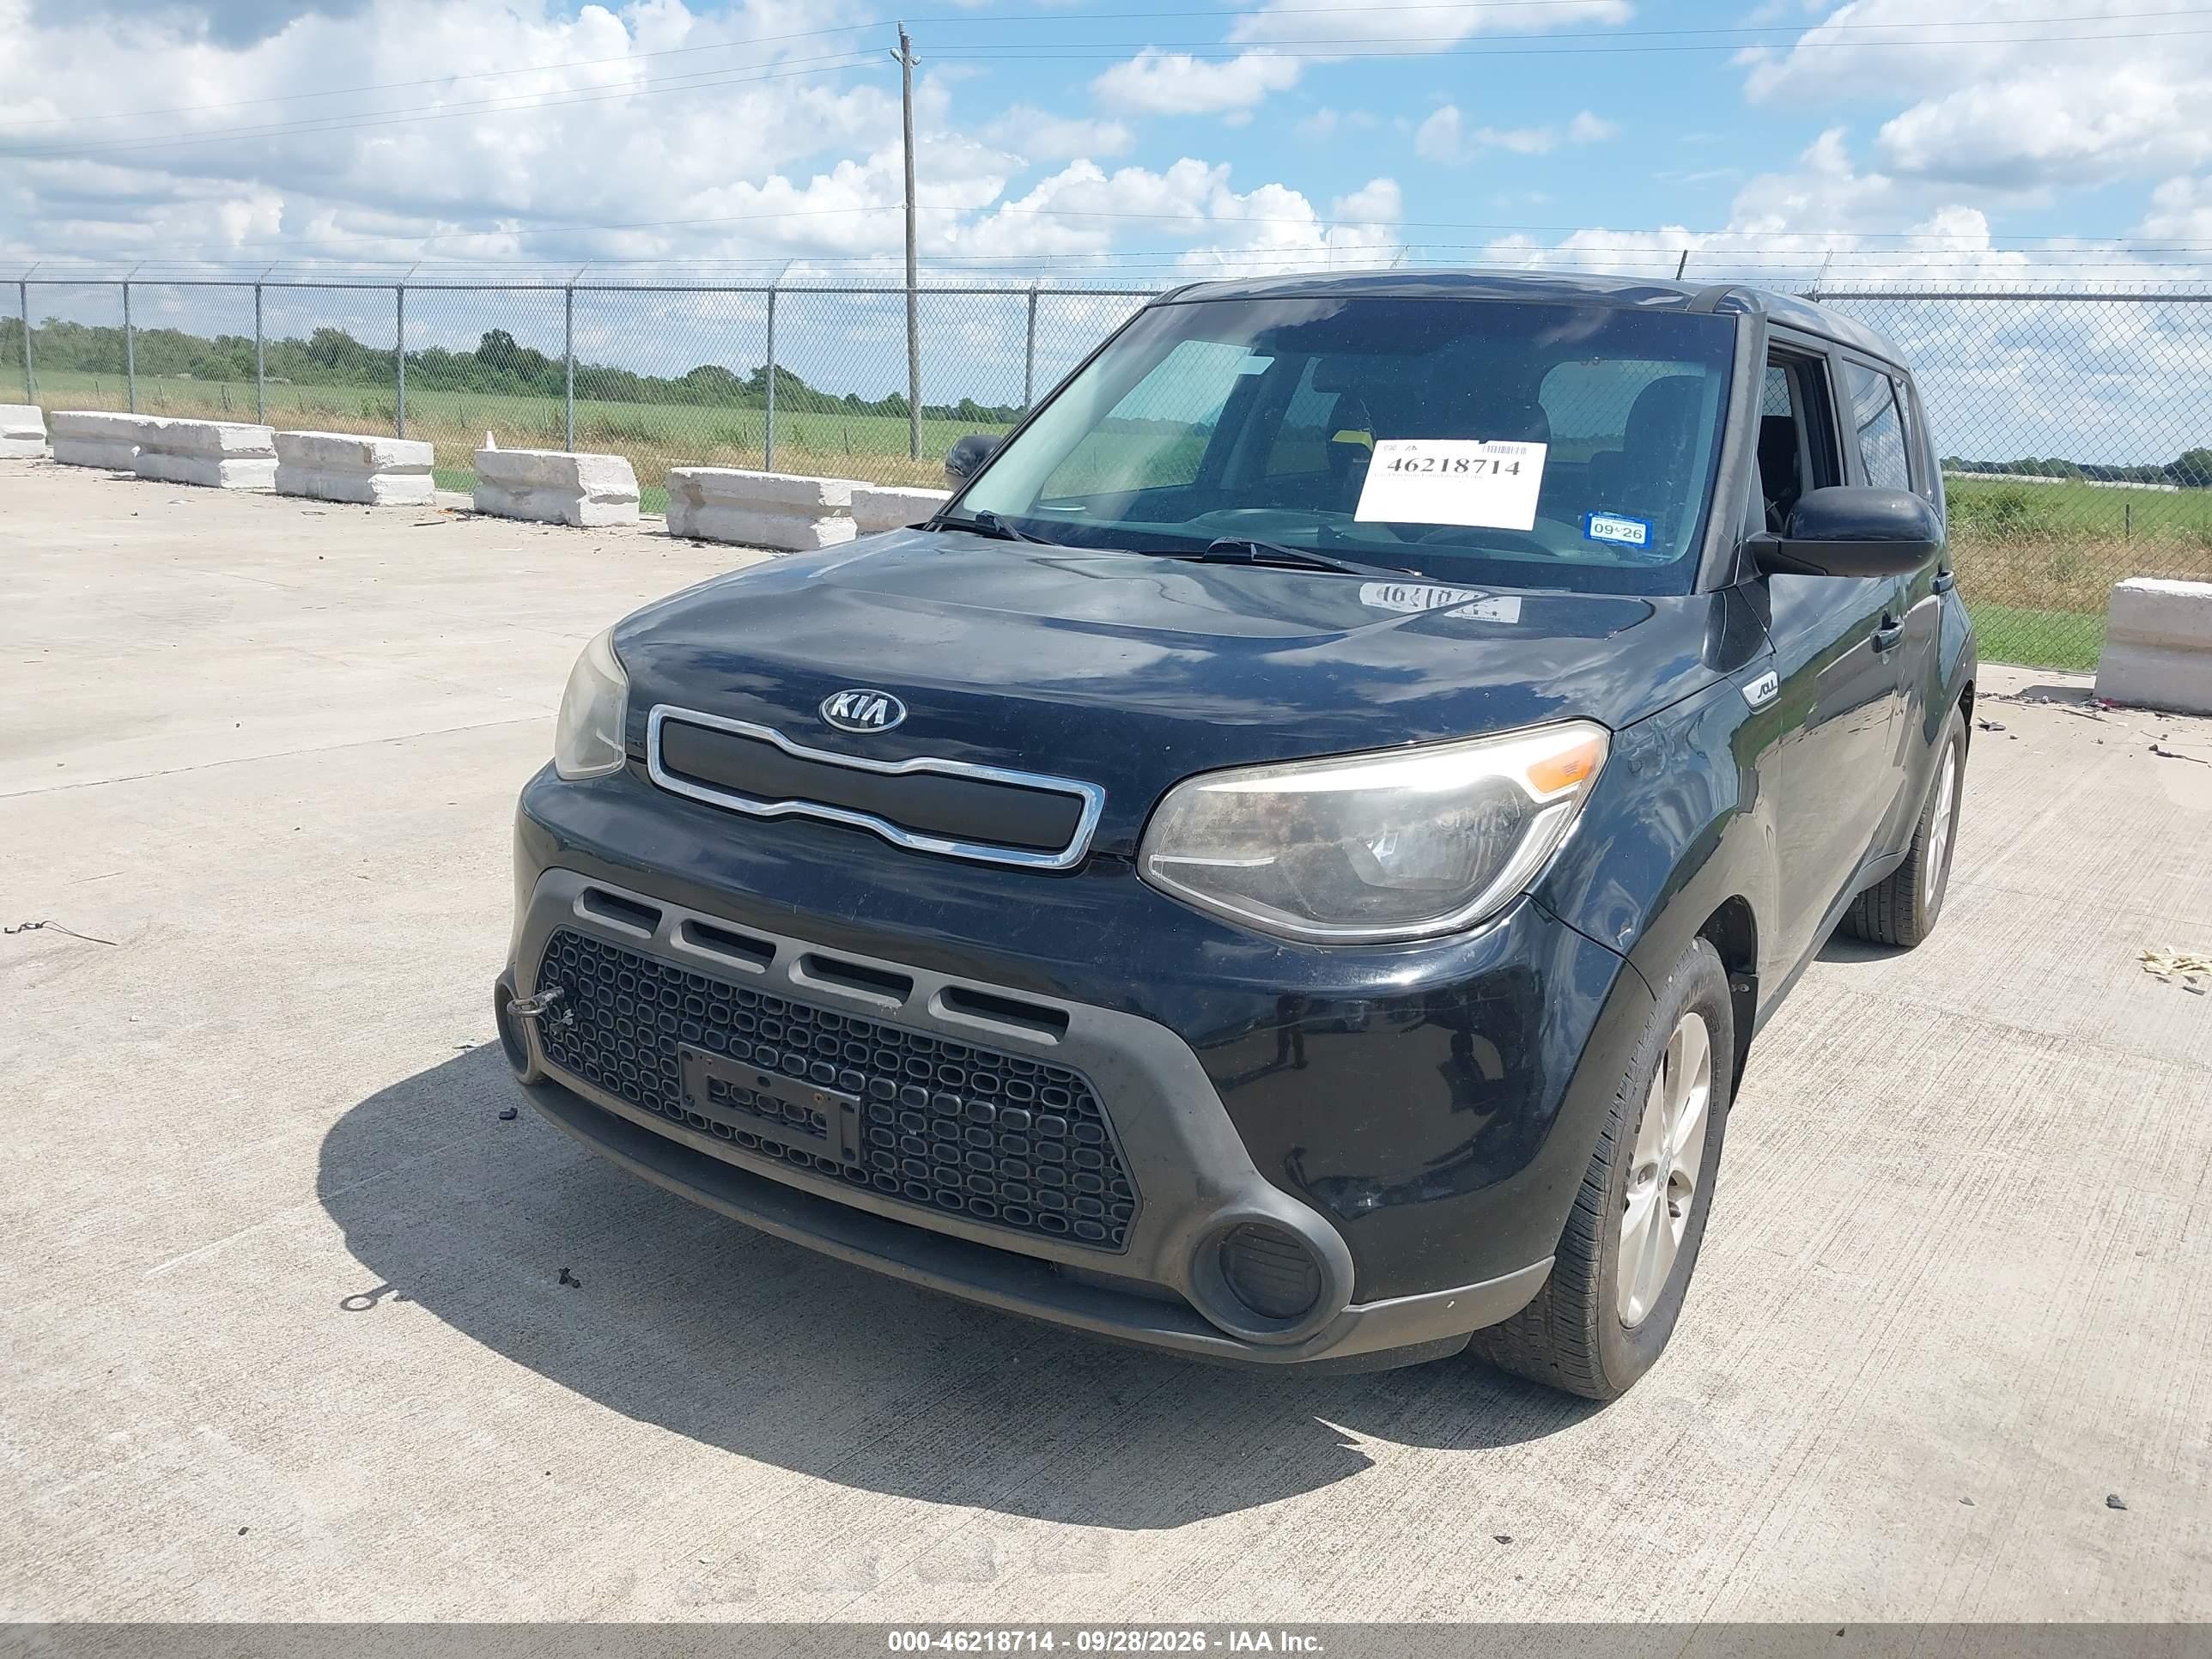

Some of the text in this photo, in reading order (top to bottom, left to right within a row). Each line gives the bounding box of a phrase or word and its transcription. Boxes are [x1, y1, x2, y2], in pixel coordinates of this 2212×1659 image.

[1387, 458, 1521, 475] 46218714
[1594, 523, 1613, 535] 09
[1623, 527, 1643, 539] 26
[830, 693, 888, 725] KIA
